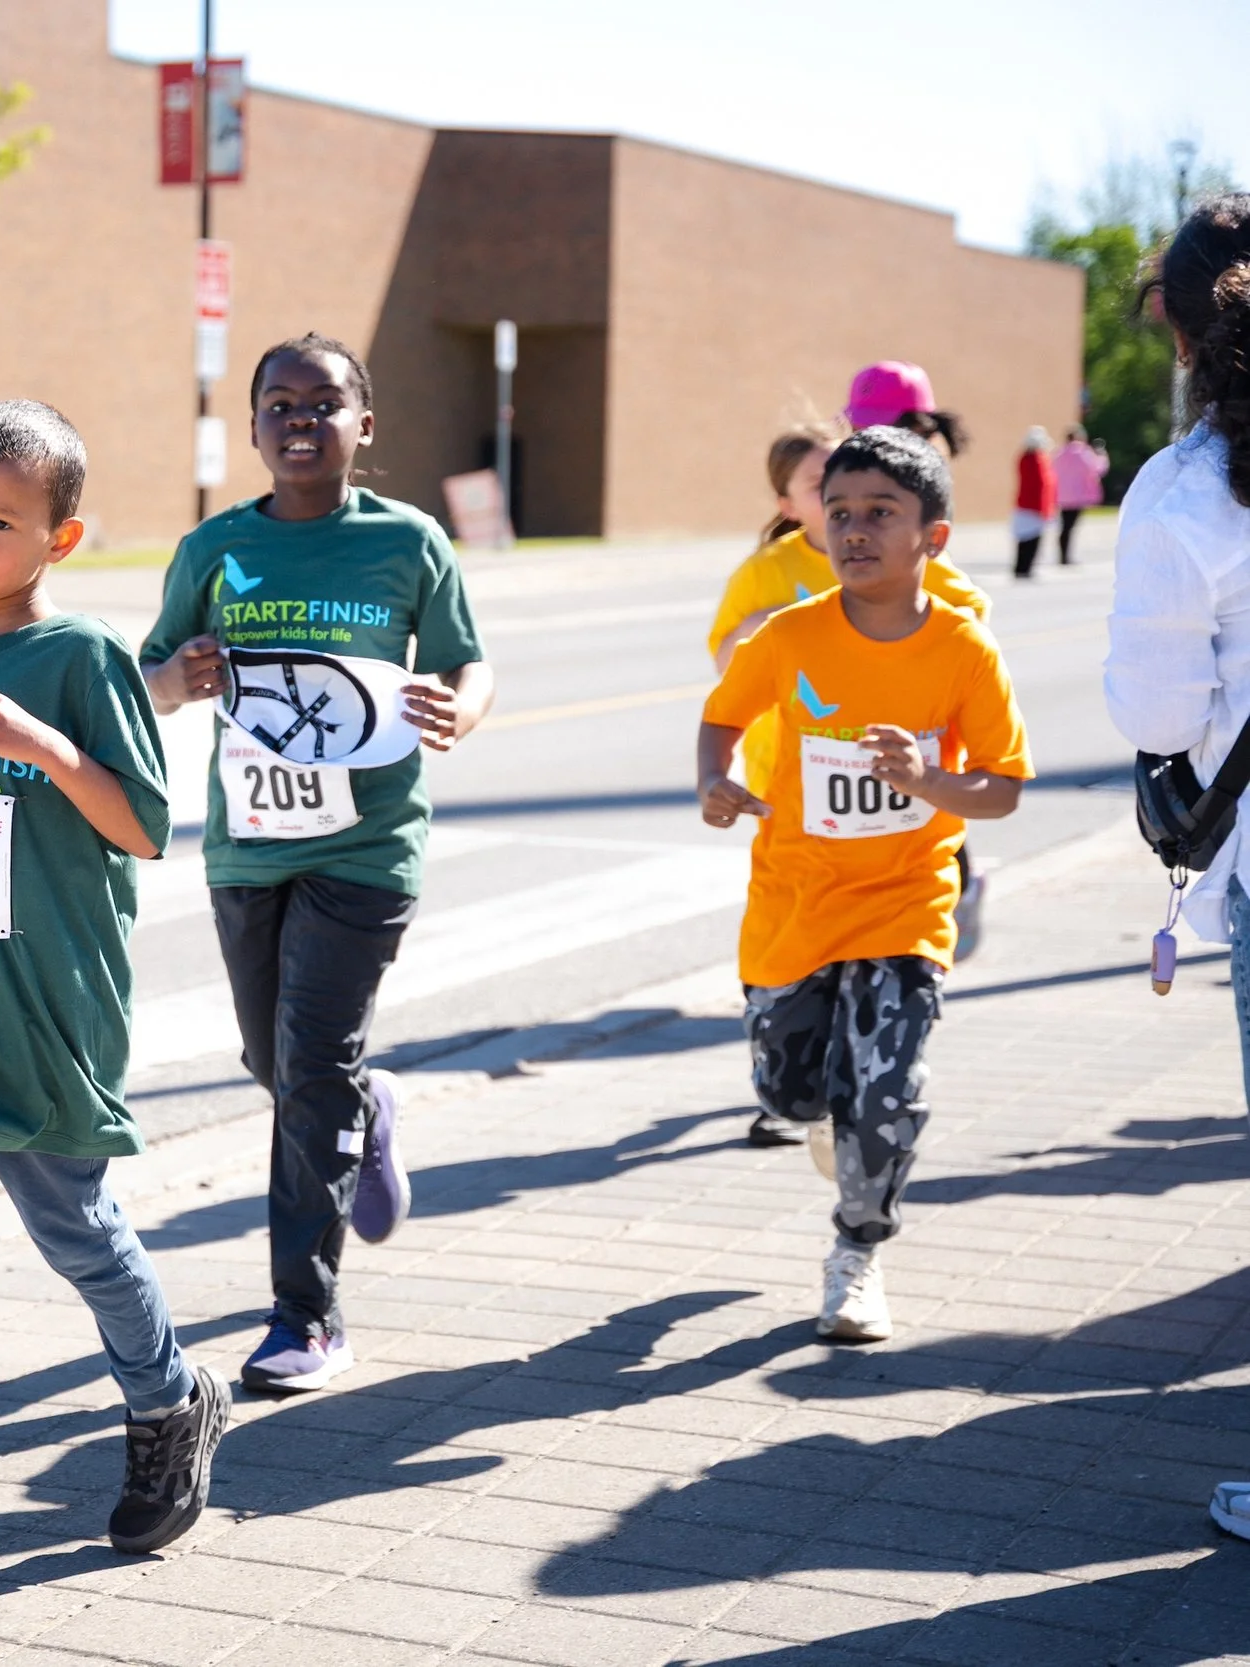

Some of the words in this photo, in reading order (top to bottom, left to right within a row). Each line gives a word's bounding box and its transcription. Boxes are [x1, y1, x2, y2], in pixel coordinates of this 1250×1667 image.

[221, 600, 391, 628] START2FINISH
[280, 627, 308, 641] kids
[310, 627, 330, 641] for
[331, 628, 352, 643] life
[244, 764, 323, 811] 209
